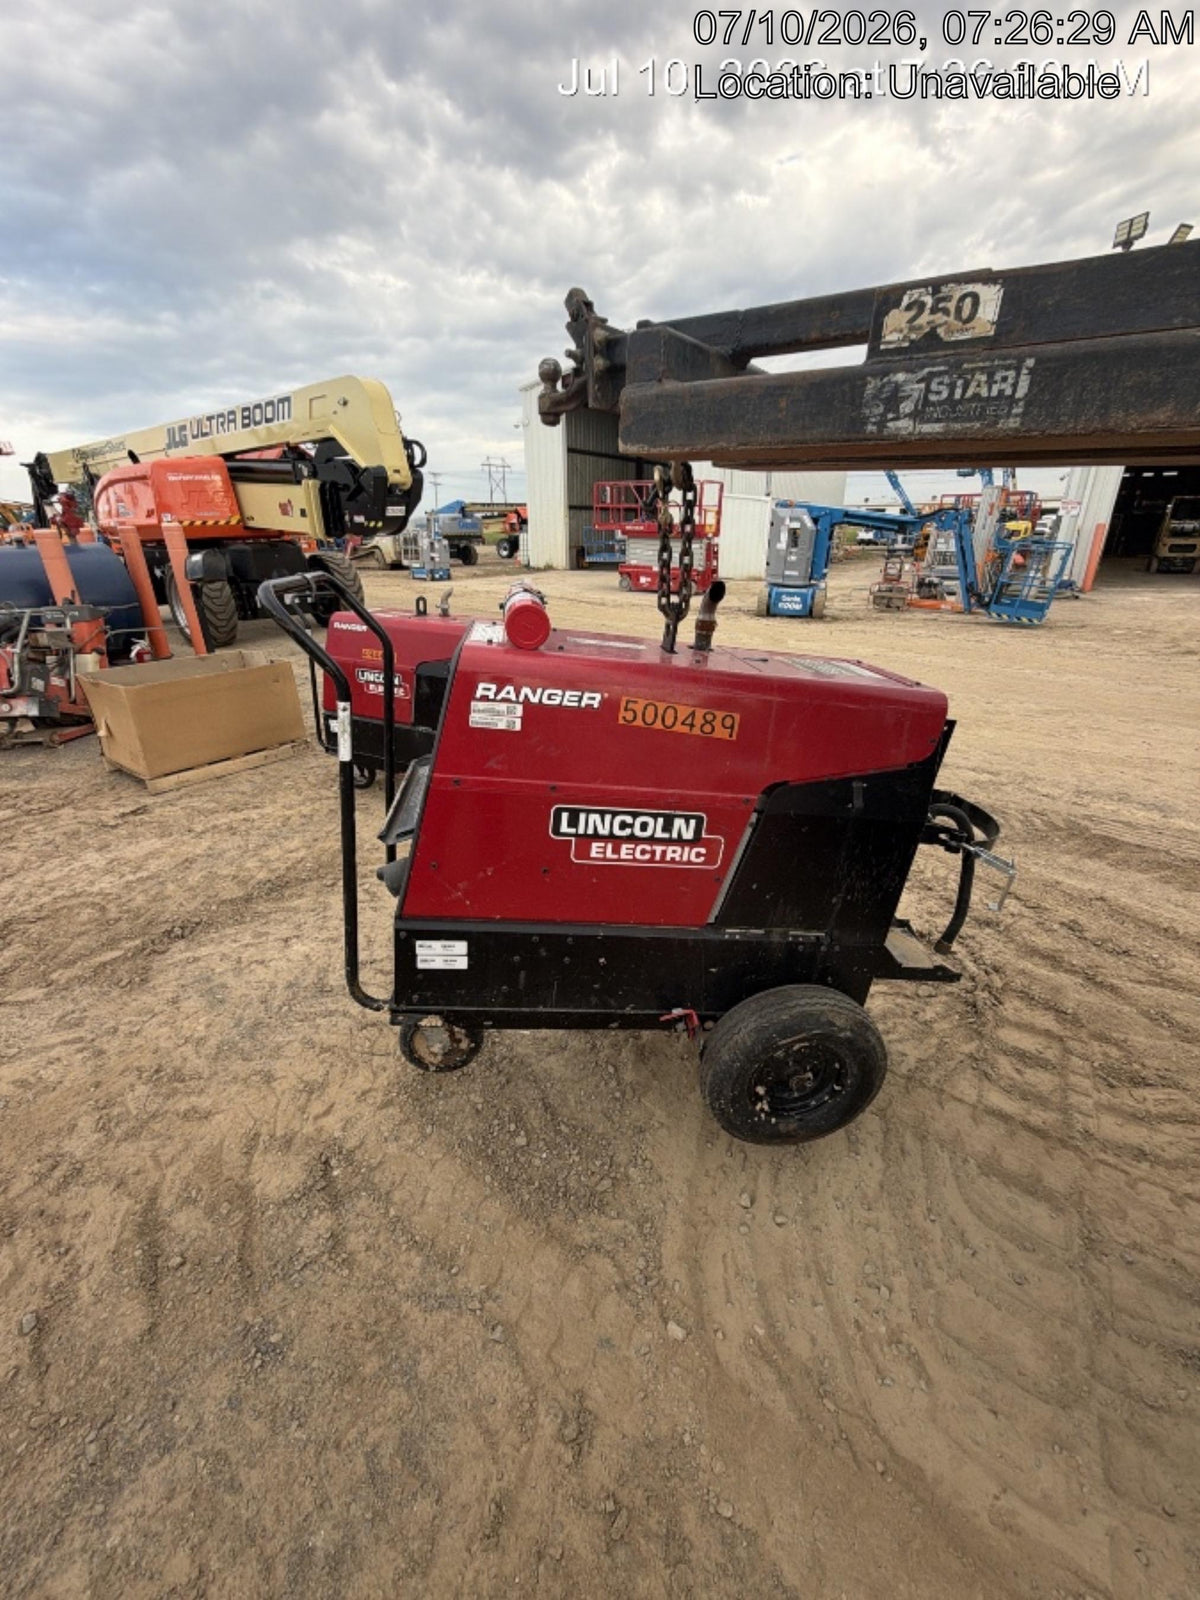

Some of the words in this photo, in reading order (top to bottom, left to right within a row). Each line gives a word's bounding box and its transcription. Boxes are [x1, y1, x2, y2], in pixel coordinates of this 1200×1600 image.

[904, 290, 981, 326] 250
[166, 425, 189, 450] JLG
[190, 409, 238, 440] ULTRA
[241, 395, 292, 430] BOOM
[358, 669, 400, 686] LINCON
[474, 682, 602, 709] RANGER
[622, 699, 737, 740] 500489
[559, 811, 697, 842] LINCOLN
[588, 841, 708, 864] ELECTRIC
